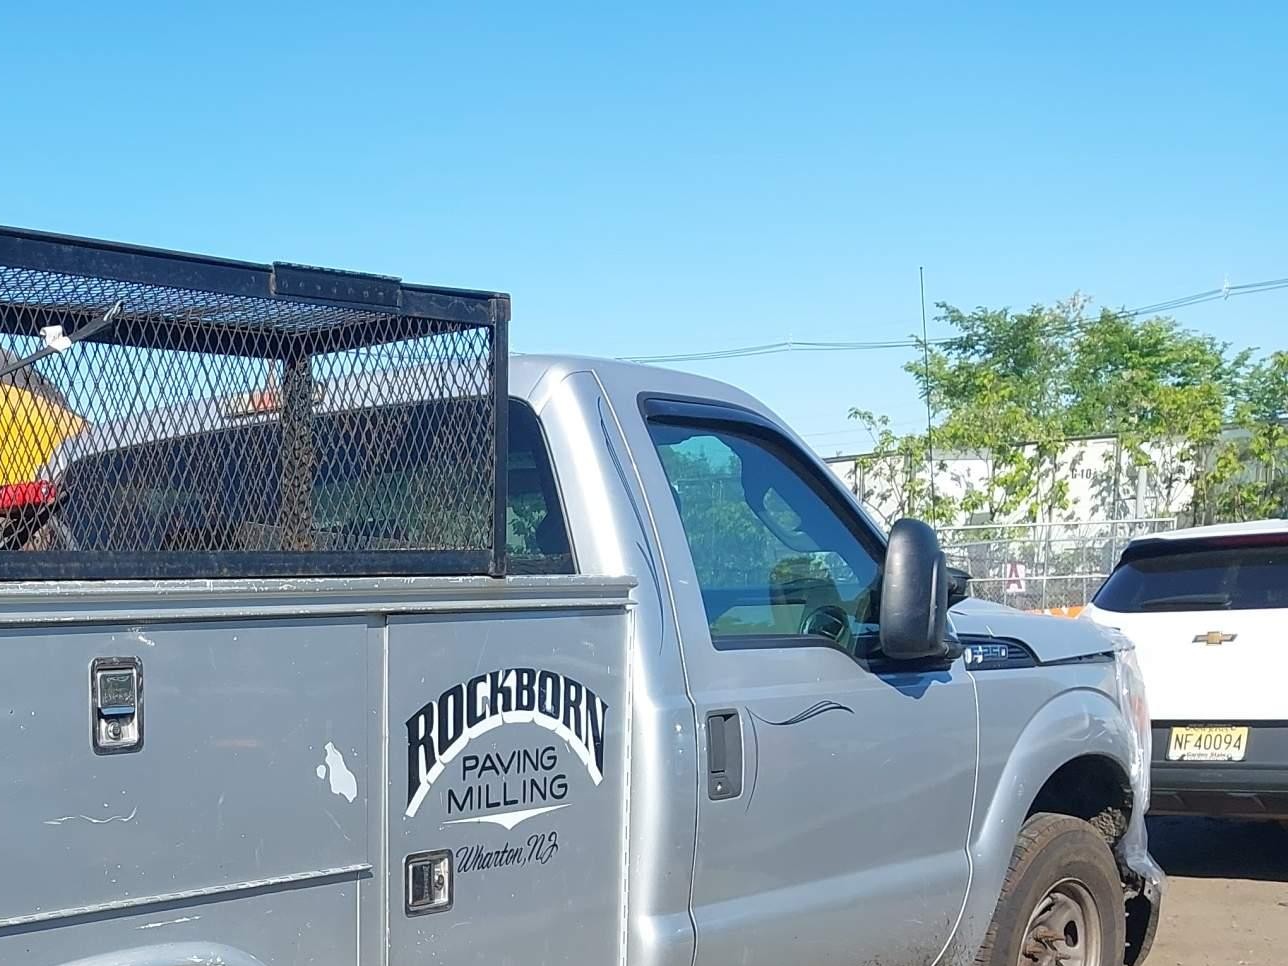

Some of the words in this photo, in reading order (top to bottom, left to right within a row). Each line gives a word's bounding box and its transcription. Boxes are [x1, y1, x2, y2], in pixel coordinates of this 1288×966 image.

[405, 668, 609, 808] ROCKBORN
[1174, 733, 1243, 751] NF40094
[463, 746, 558, 781] PAVING
[447, 774, 569, 814] MILLING
